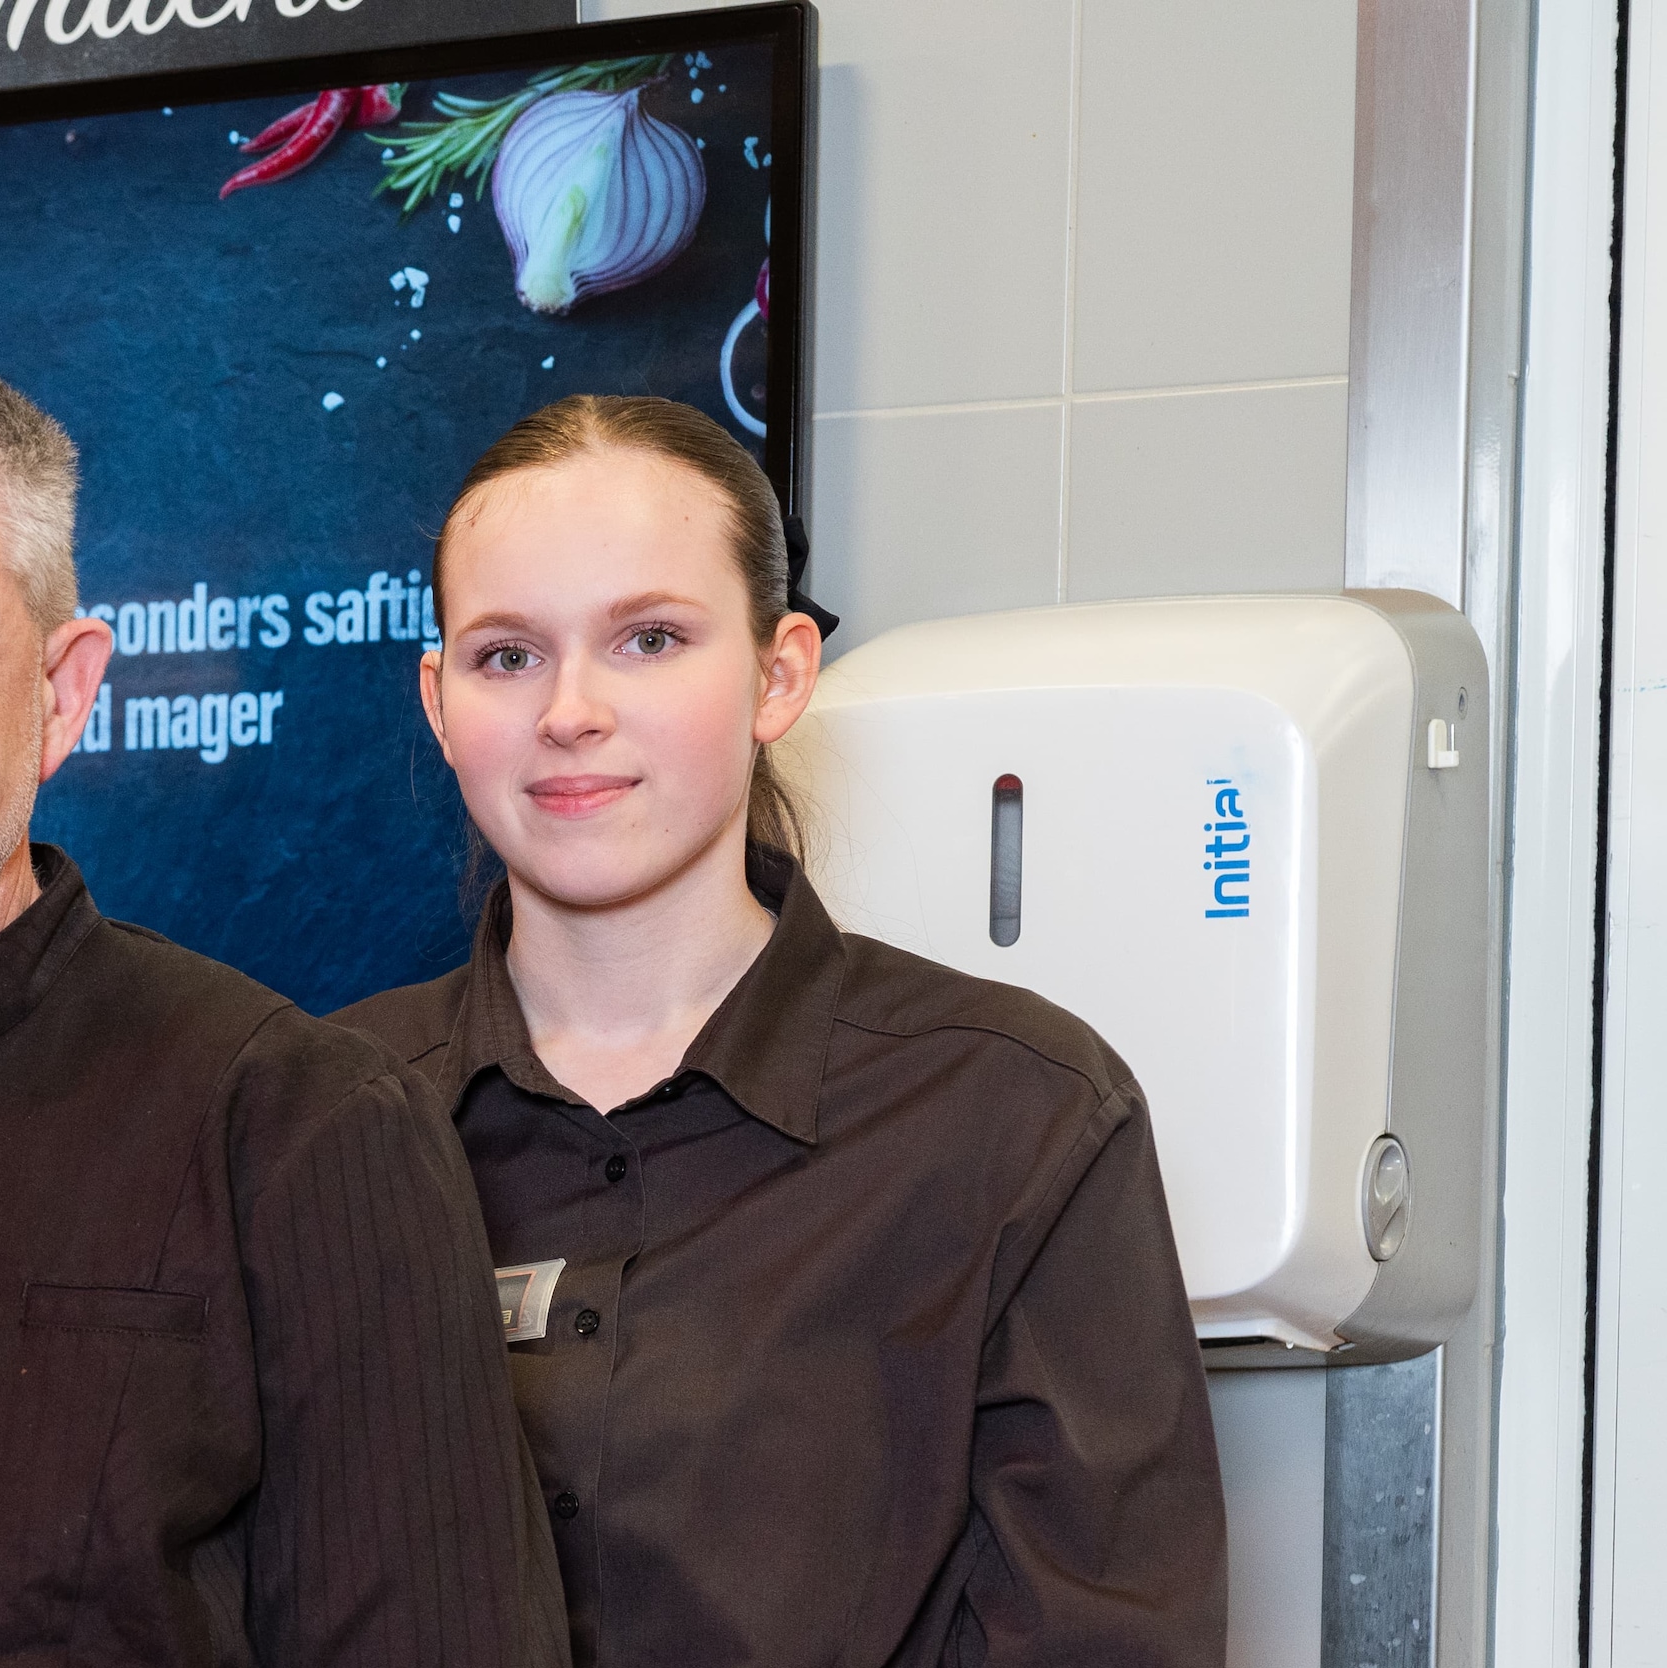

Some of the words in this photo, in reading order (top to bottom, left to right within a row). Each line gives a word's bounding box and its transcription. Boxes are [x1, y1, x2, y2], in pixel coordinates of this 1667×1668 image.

[74, 582, 292, 657] onders
[70, 683, 113, 756] d
[124, 689, 285, 765] mager
[1203, 778, 1251, 919] Initia
